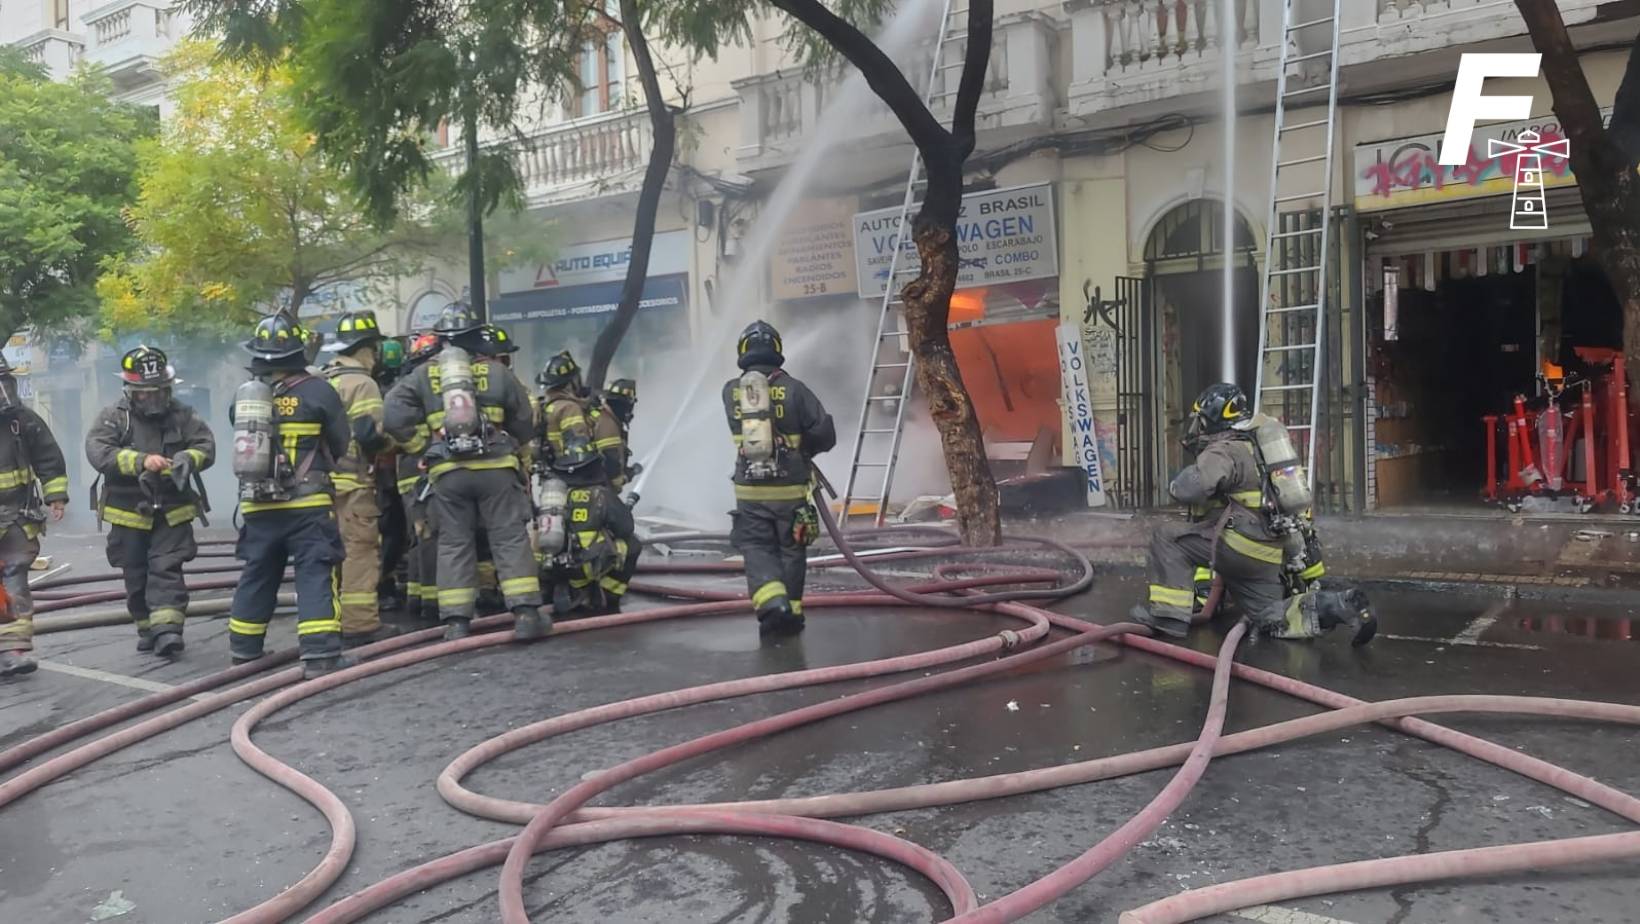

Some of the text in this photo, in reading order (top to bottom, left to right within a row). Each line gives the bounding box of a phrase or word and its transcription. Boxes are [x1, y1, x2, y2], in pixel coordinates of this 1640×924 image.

[979, 194, 1045, 216] BRASIL
[985, 234, 1044, 251] ESCARABAJO
[556, 250, 632, 273] AUTO EQUIP
[994, 250, 1040, 265] COMBO
[142, 361, 159, 375] 17
[1067, 340, 1101, 494] VOLKSWAGEN
